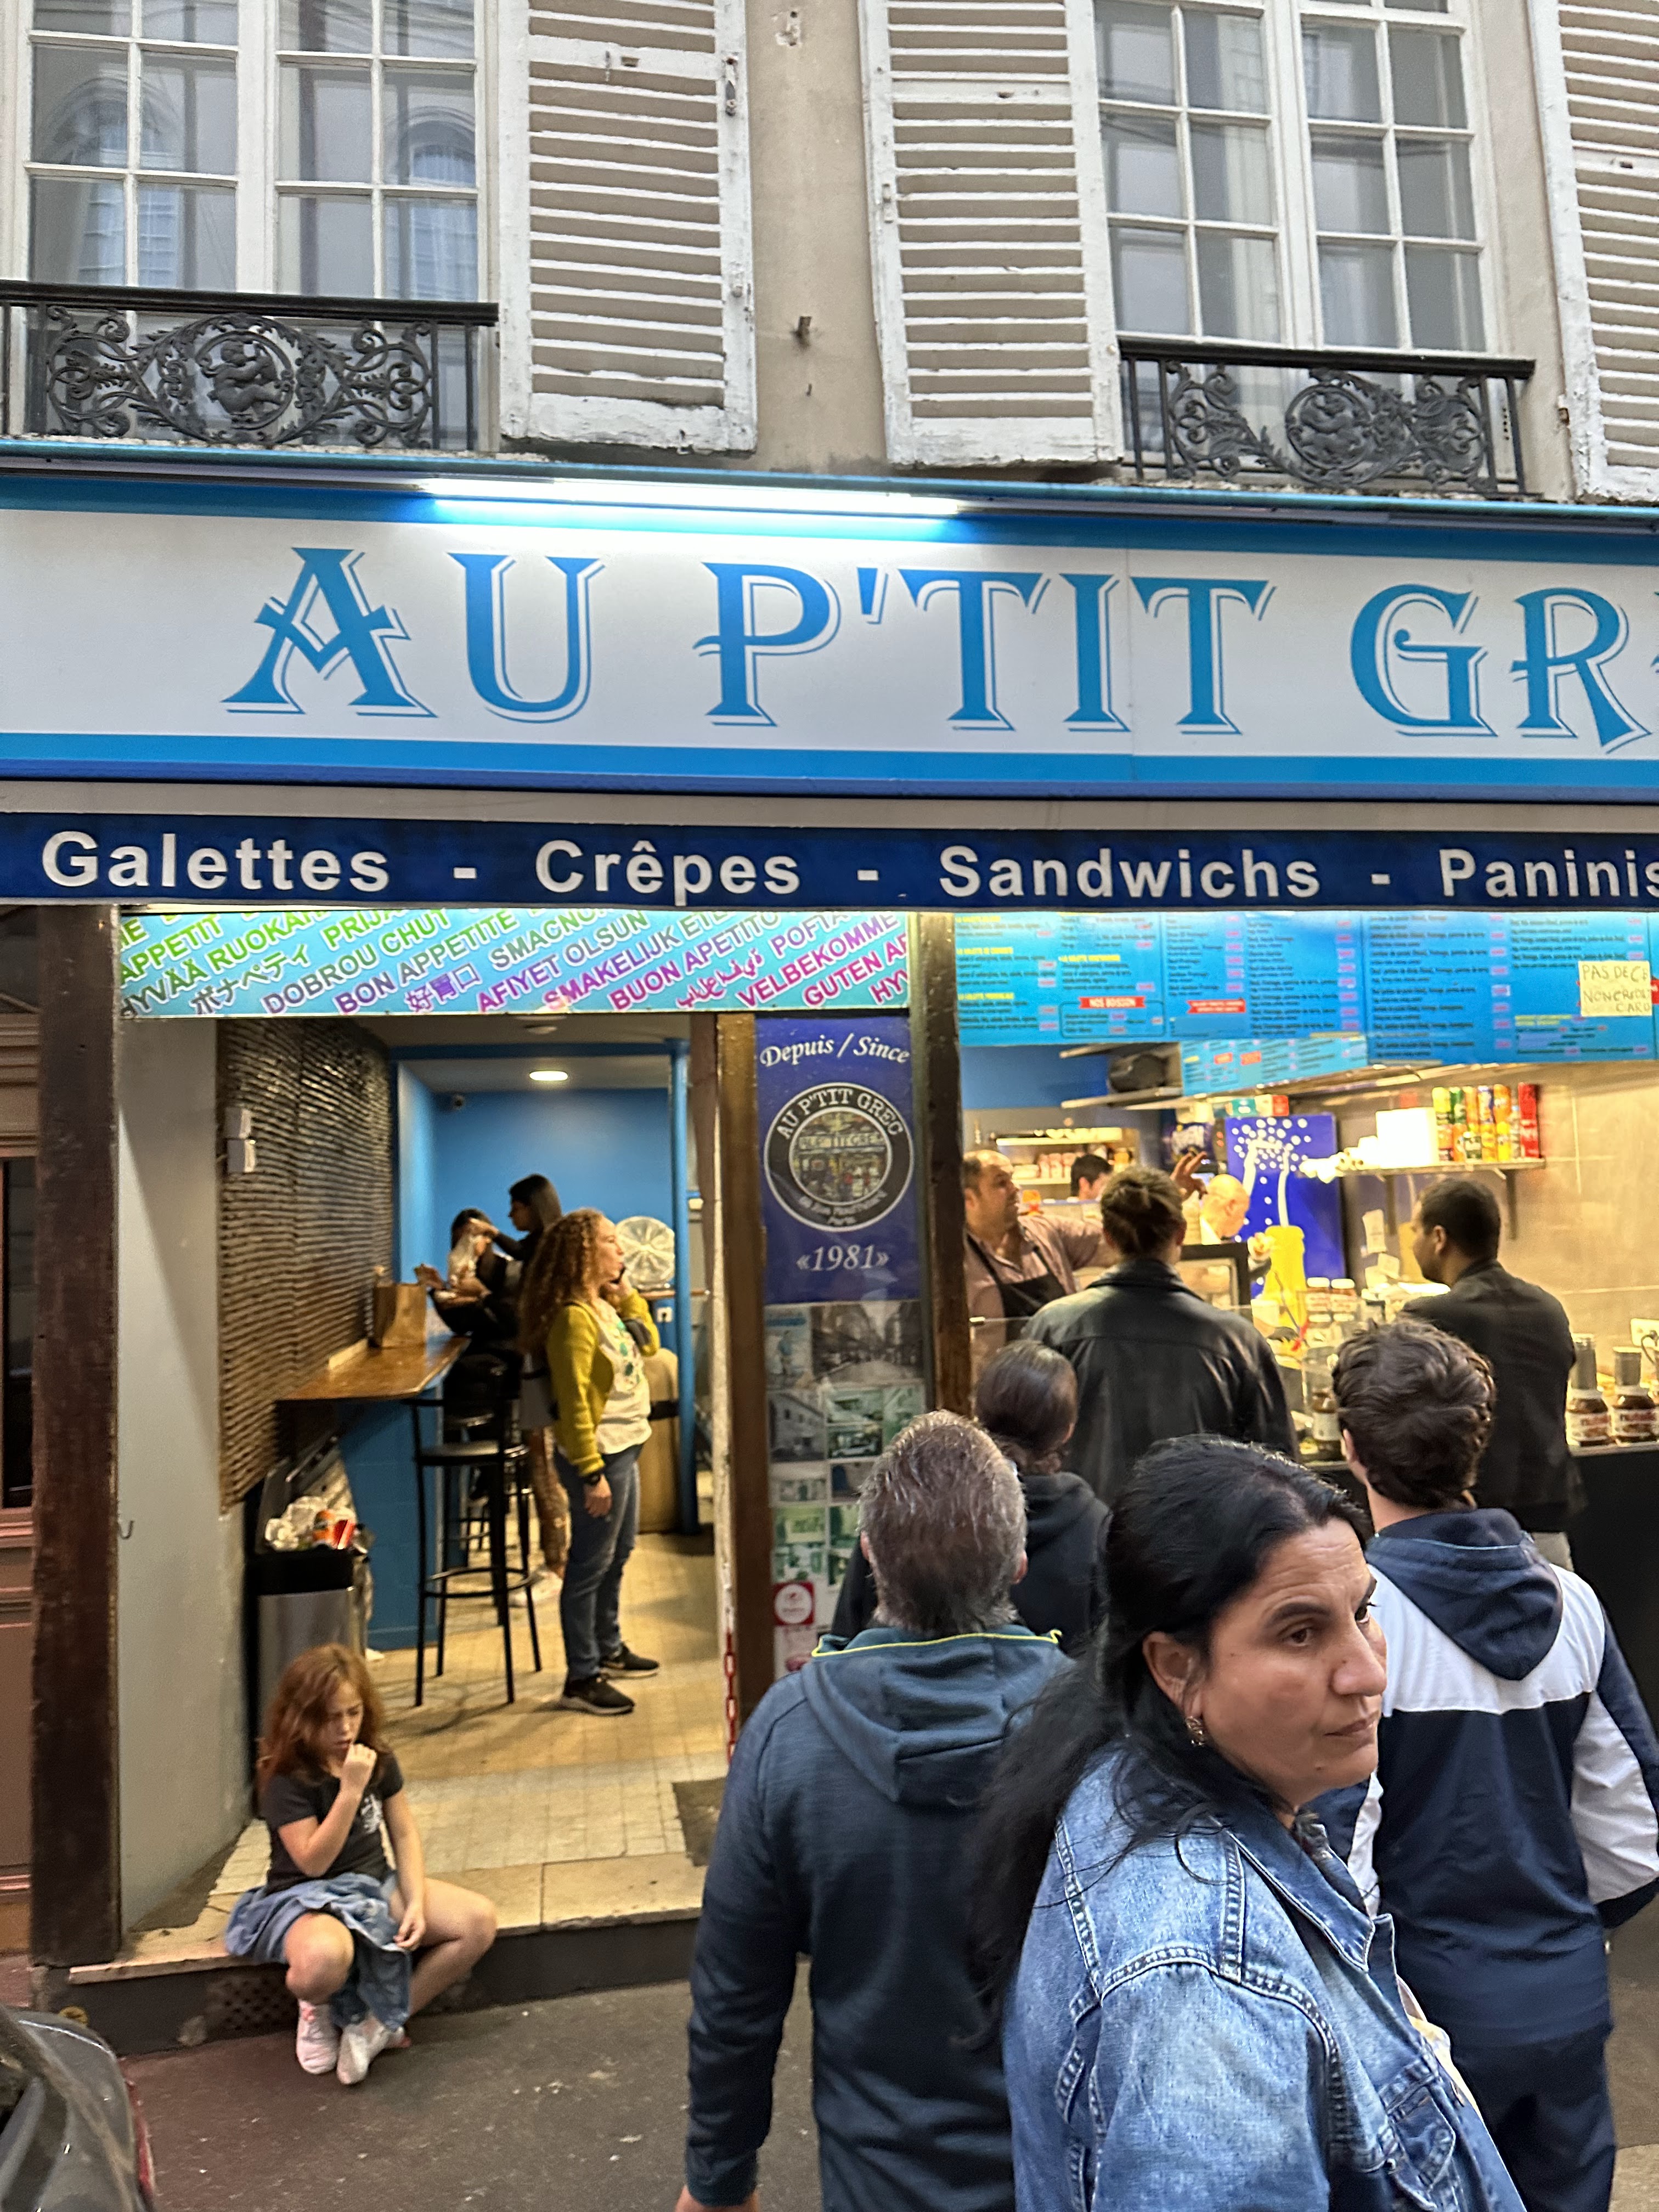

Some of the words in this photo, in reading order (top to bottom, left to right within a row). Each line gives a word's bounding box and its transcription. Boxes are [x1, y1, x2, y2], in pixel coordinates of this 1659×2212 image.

[221, 546, 606, 724] AU
[693, 562, 1277, 735] P'TIT
[1350, 584, 1659, 753] GR
[42, 830, 390, 892] Galettes
[535, 839, 801, 906] Crêpes
[939, 845, 1320, 898] Sandwichs
[1440, 848, 1659, 899] Paninis
[121, 913, 221, 985] APPETIT
[263, 943, 377, 1014] DOBROU
[381, 910, 449, 953] CHUT
[335, 971, 396, 1013] BON
[399, 910, 518, 984] APPETITE
[477, 953, 560, 1012] AFIYET
[565, 911, 648, 964] OLSUN
[544, 926, 681, 1011] SMAKELIJK
[609, 960, 681, 1010] BUON
[684, 912, 779, 973] APETITO
[737, 914, 899, 1007] VELBEKOMME
[804, 951, 883, 1006] GUTEN
[1582, 964, 1610, 981] PAS
[1613, 965, 1628, 979] DE
[759, 1034, 835, 1067] Depuis
[853, 1036, 910, 1064] Since
[777, 1108, 800, 1140] AU
[798, 1087, 854, 1116] P'TIT
[857, 1092, 904, 1136] GREC
